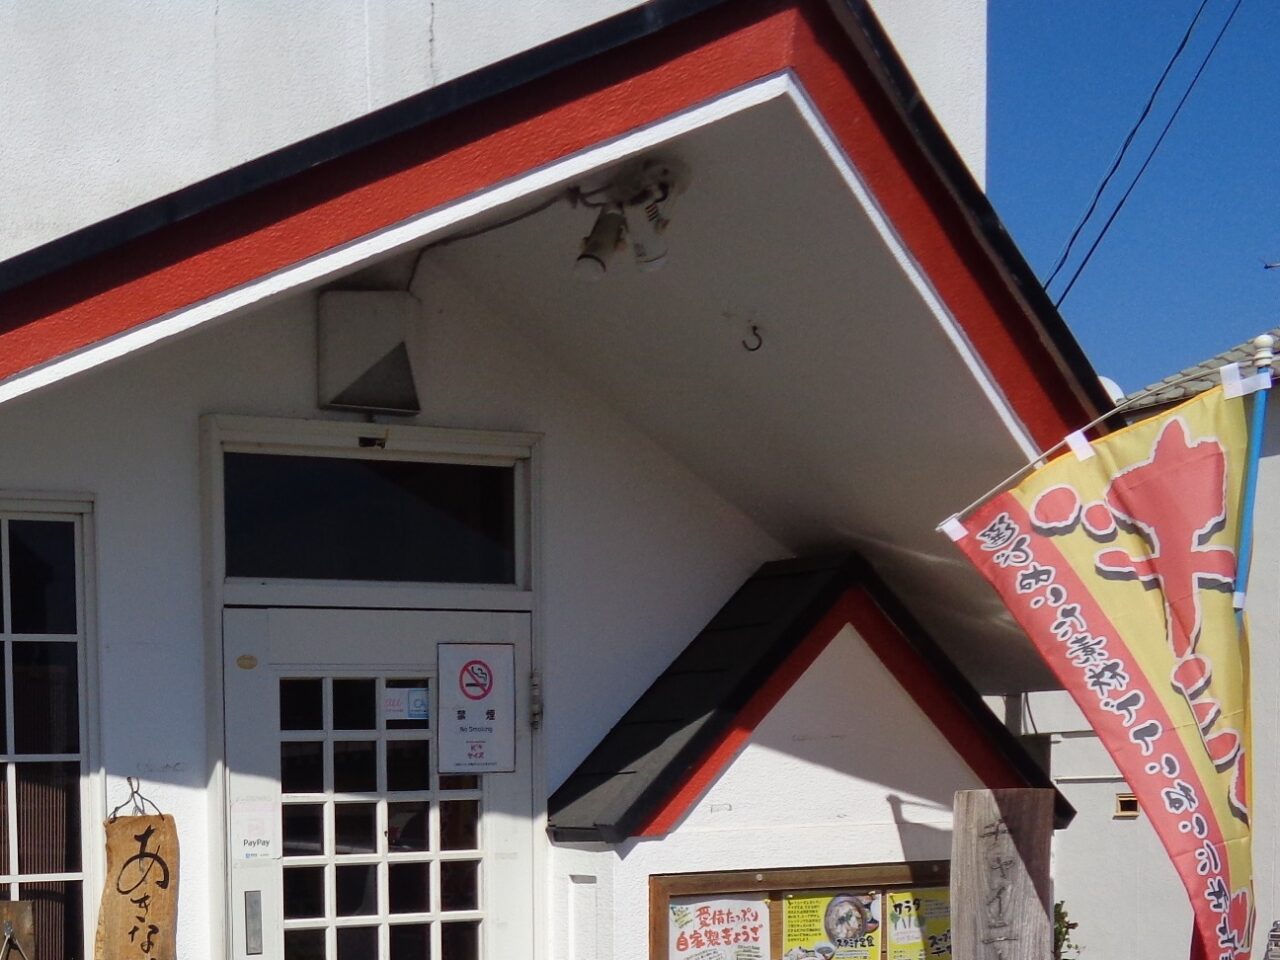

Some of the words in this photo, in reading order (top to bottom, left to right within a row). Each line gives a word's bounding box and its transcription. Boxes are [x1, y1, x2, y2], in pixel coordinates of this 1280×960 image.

[468, 726, 493, 734] Smoking
[243, 839, 270, 848] PayPay
[695, 905, 759, 929] 愛情たっぷり
[676, 923, 764, 951] 自家製ぎょうざ
